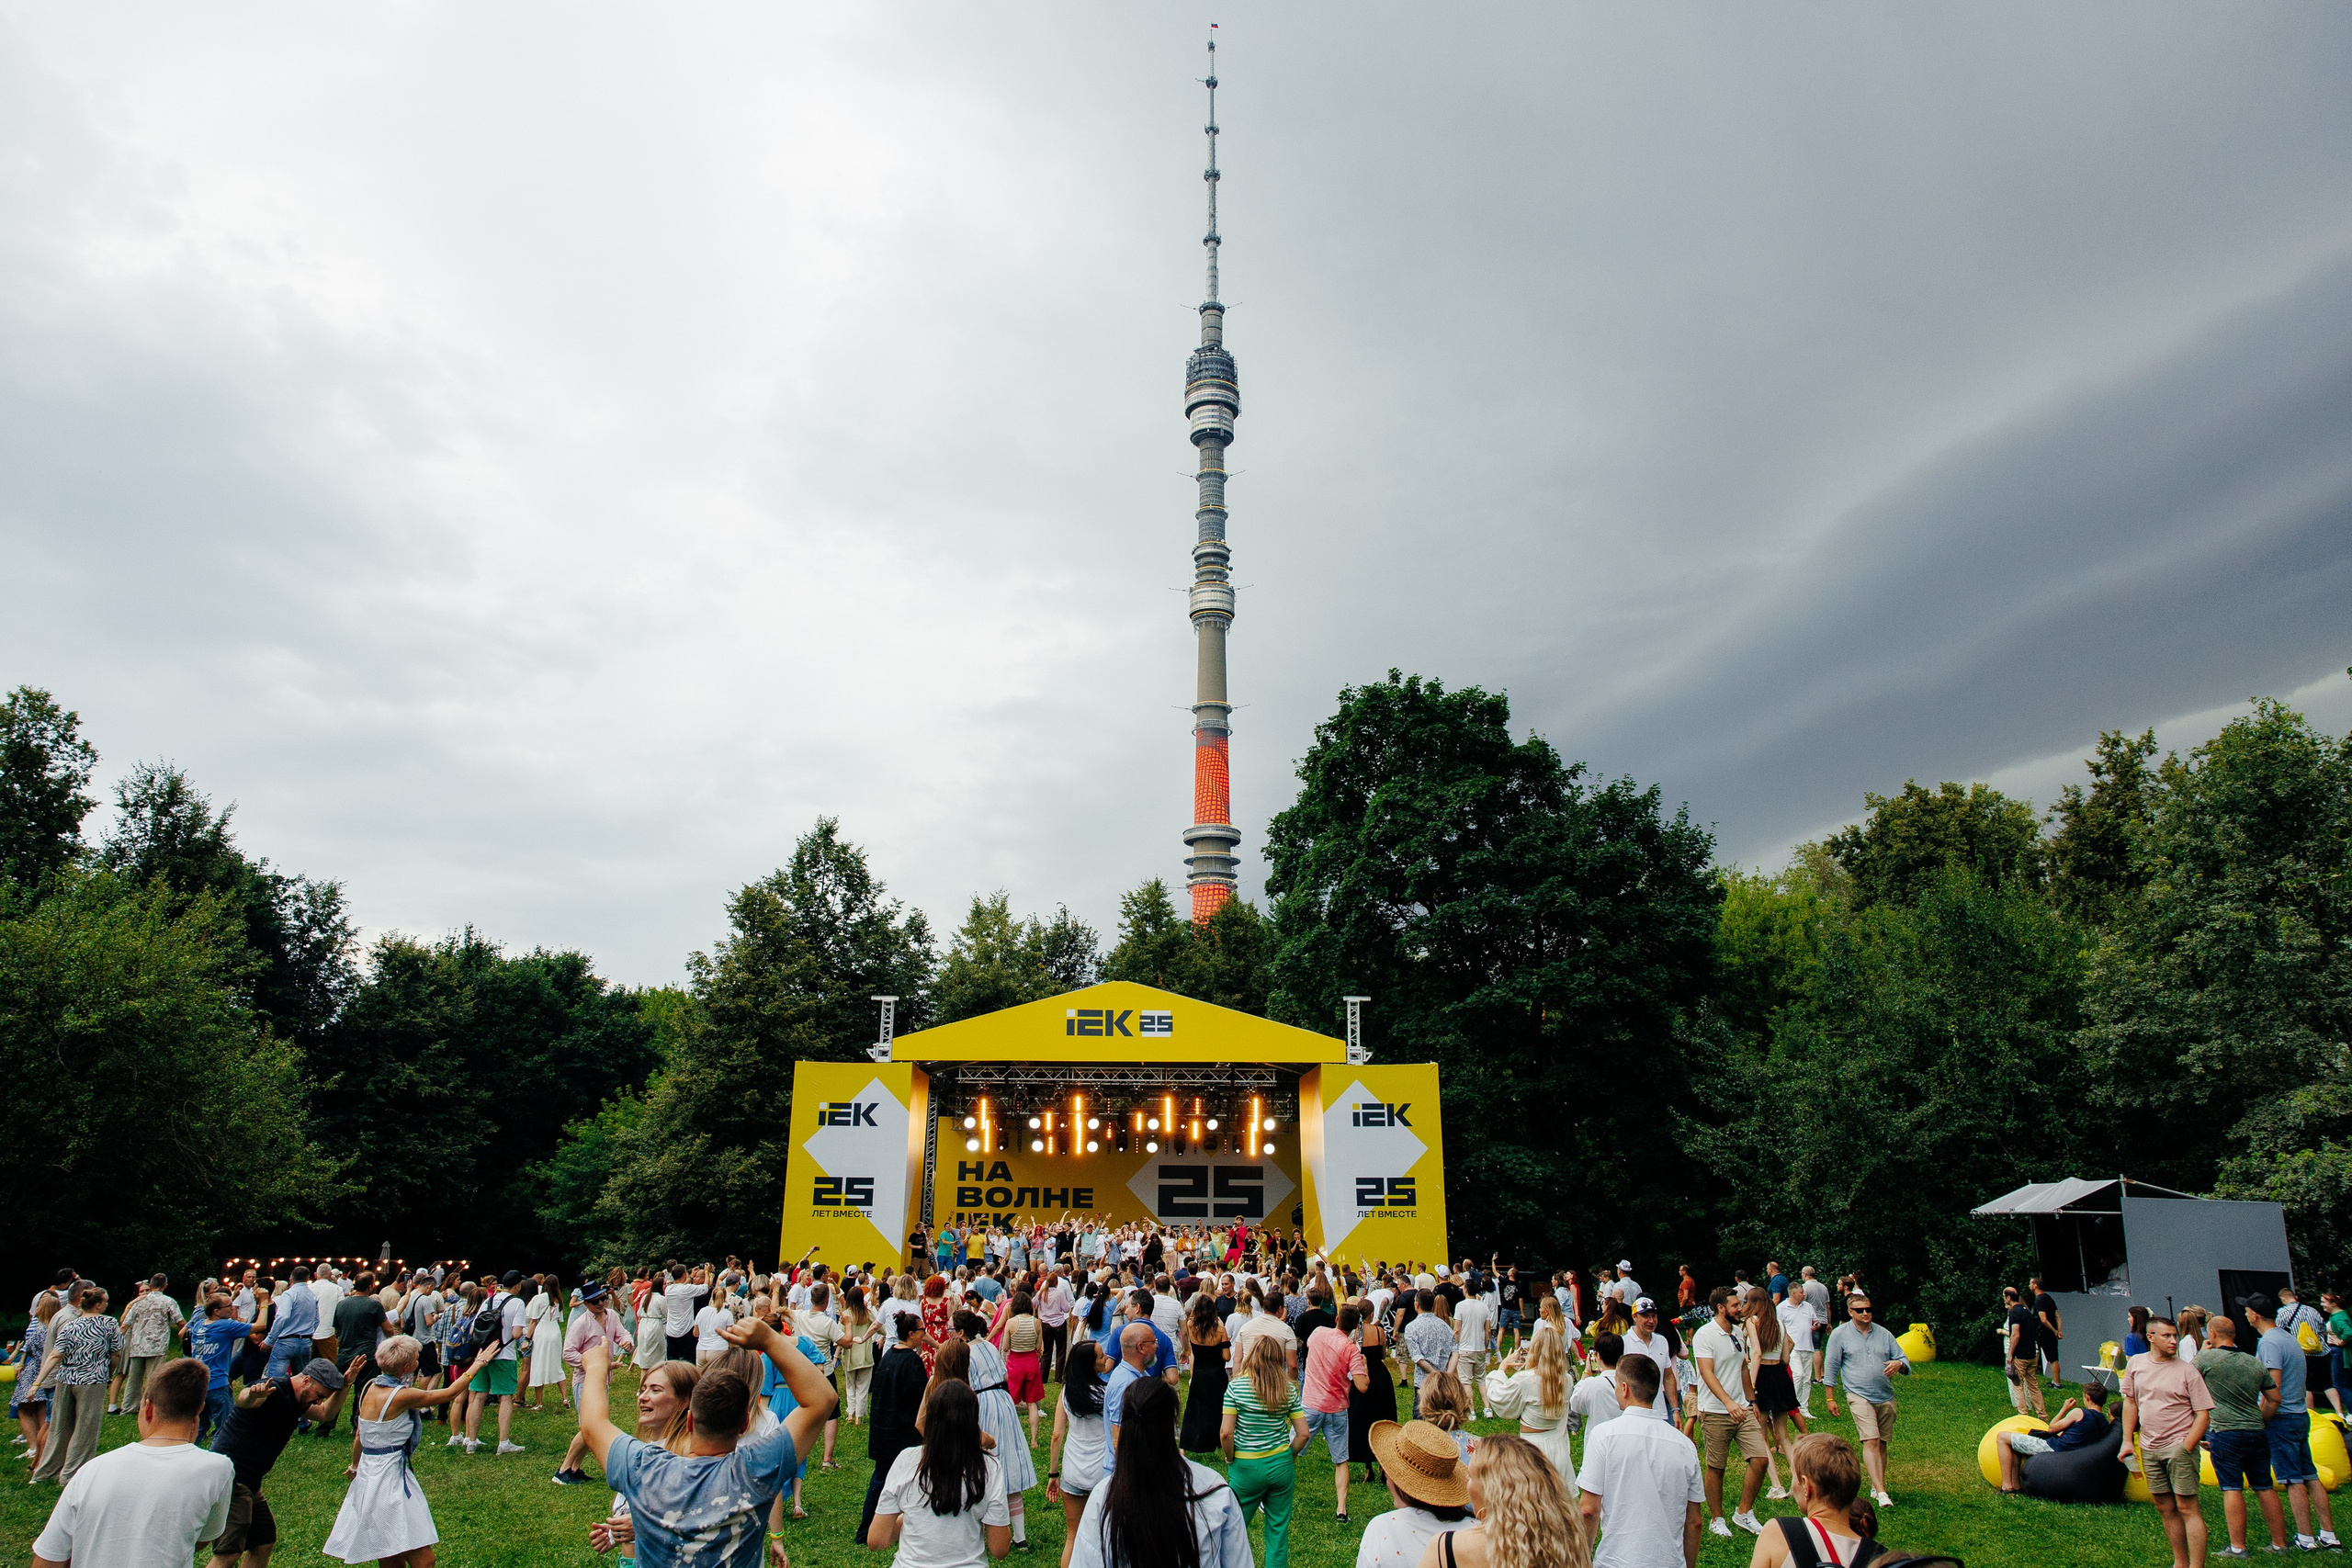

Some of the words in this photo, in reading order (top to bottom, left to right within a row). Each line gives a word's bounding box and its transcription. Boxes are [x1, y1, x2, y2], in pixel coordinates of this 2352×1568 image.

[1139, 1015, 1173, 1032] 25
[957, 1161, 1013, 1181] НА
[812, 1177, 875, 1206] 25
[956, 1187, 1093, 1208] ВОЛНЕ
[1158, 1165, 1263, 1218] 25
[1355, 1178, 1417, 1206] 25
[811, 1210, 831, 1218] ЛЕТ
[832, 1210, 873, 1218] ВМЕСТЕ
